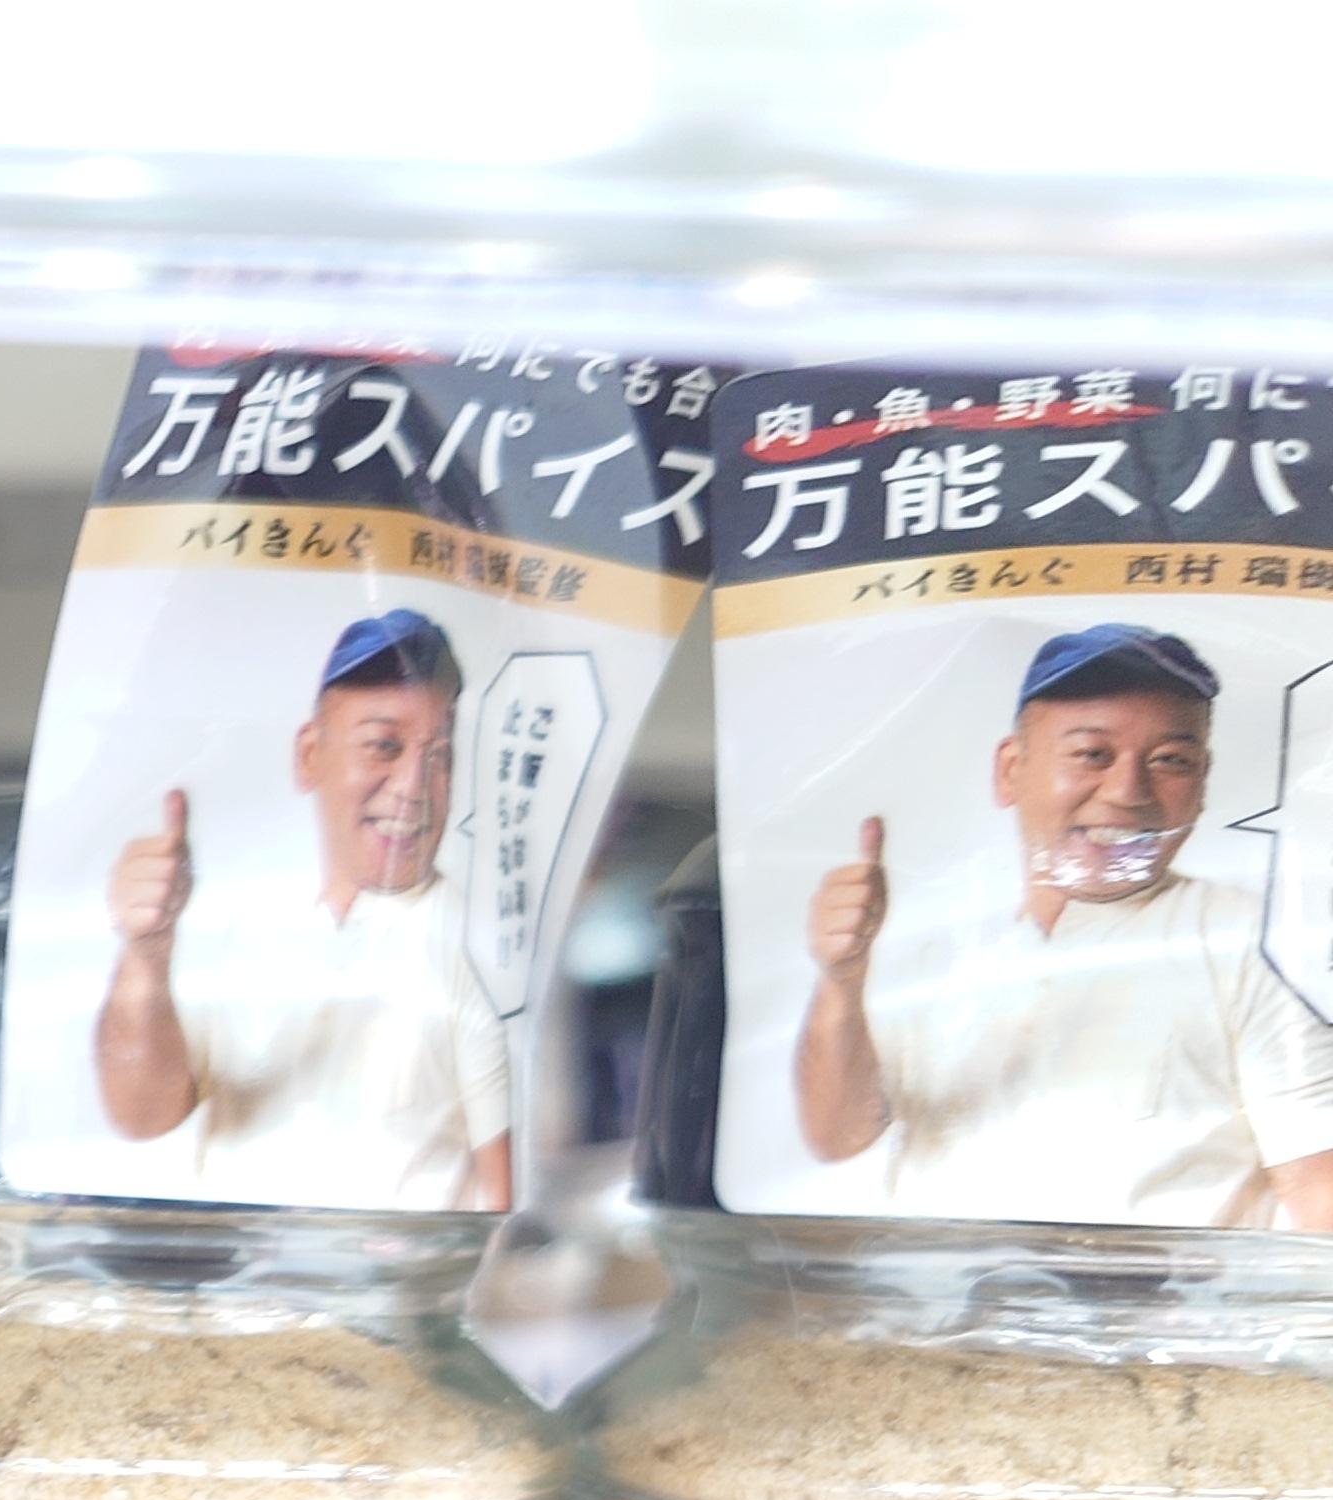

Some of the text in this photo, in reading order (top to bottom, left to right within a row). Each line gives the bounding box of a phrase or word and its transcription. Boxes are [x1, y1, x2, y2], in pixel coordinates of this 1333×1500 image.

[121, 369, 715, 546] 万能スパイス
[752, 366, 1333, 453] 肉・魚・野菜 何に
[740, 437, 1333, 561] 万能スパ
